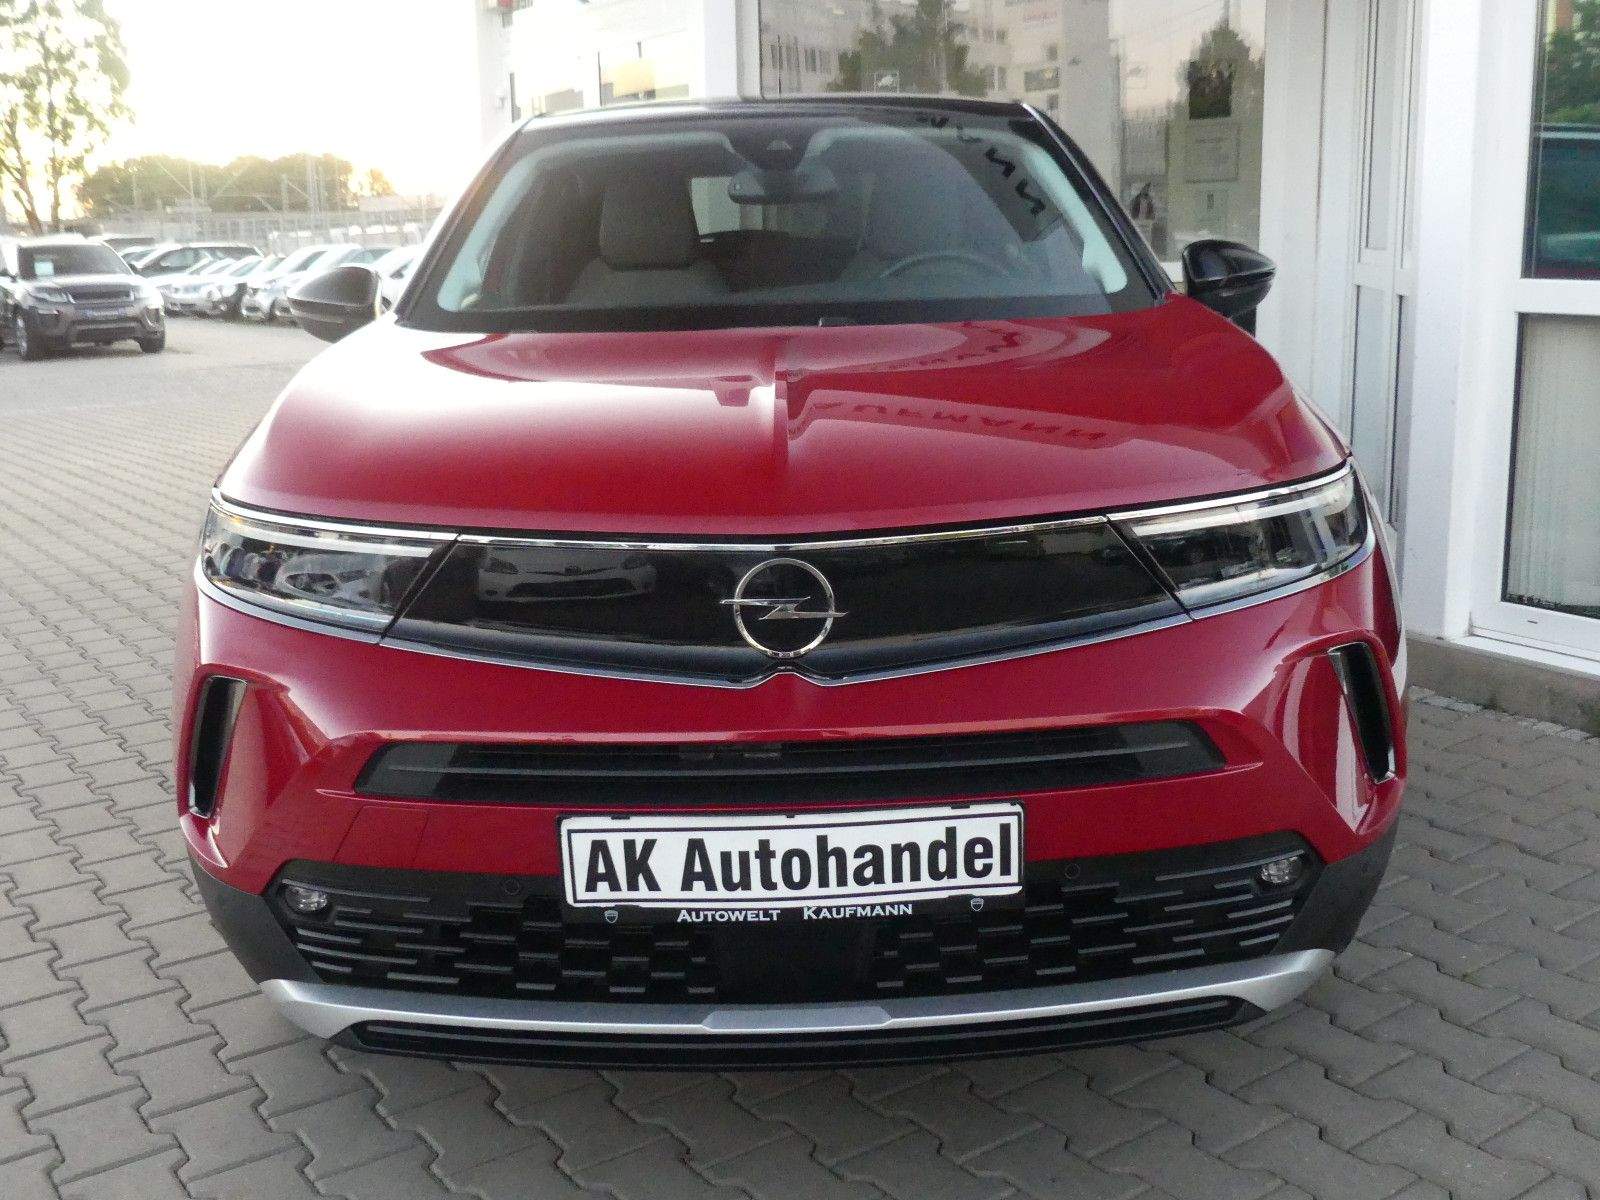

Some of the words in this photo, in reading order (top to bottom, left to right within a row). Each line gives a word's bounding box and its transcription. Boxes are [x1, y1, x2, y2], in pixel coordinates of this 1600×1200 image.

[584, 838, 661, 893] AK
[680, 822, 1012, 892] Autohandel
[677, 908, 781, 922] AUTOWELT
[803, 904, 913, 920] KAUFMANN
